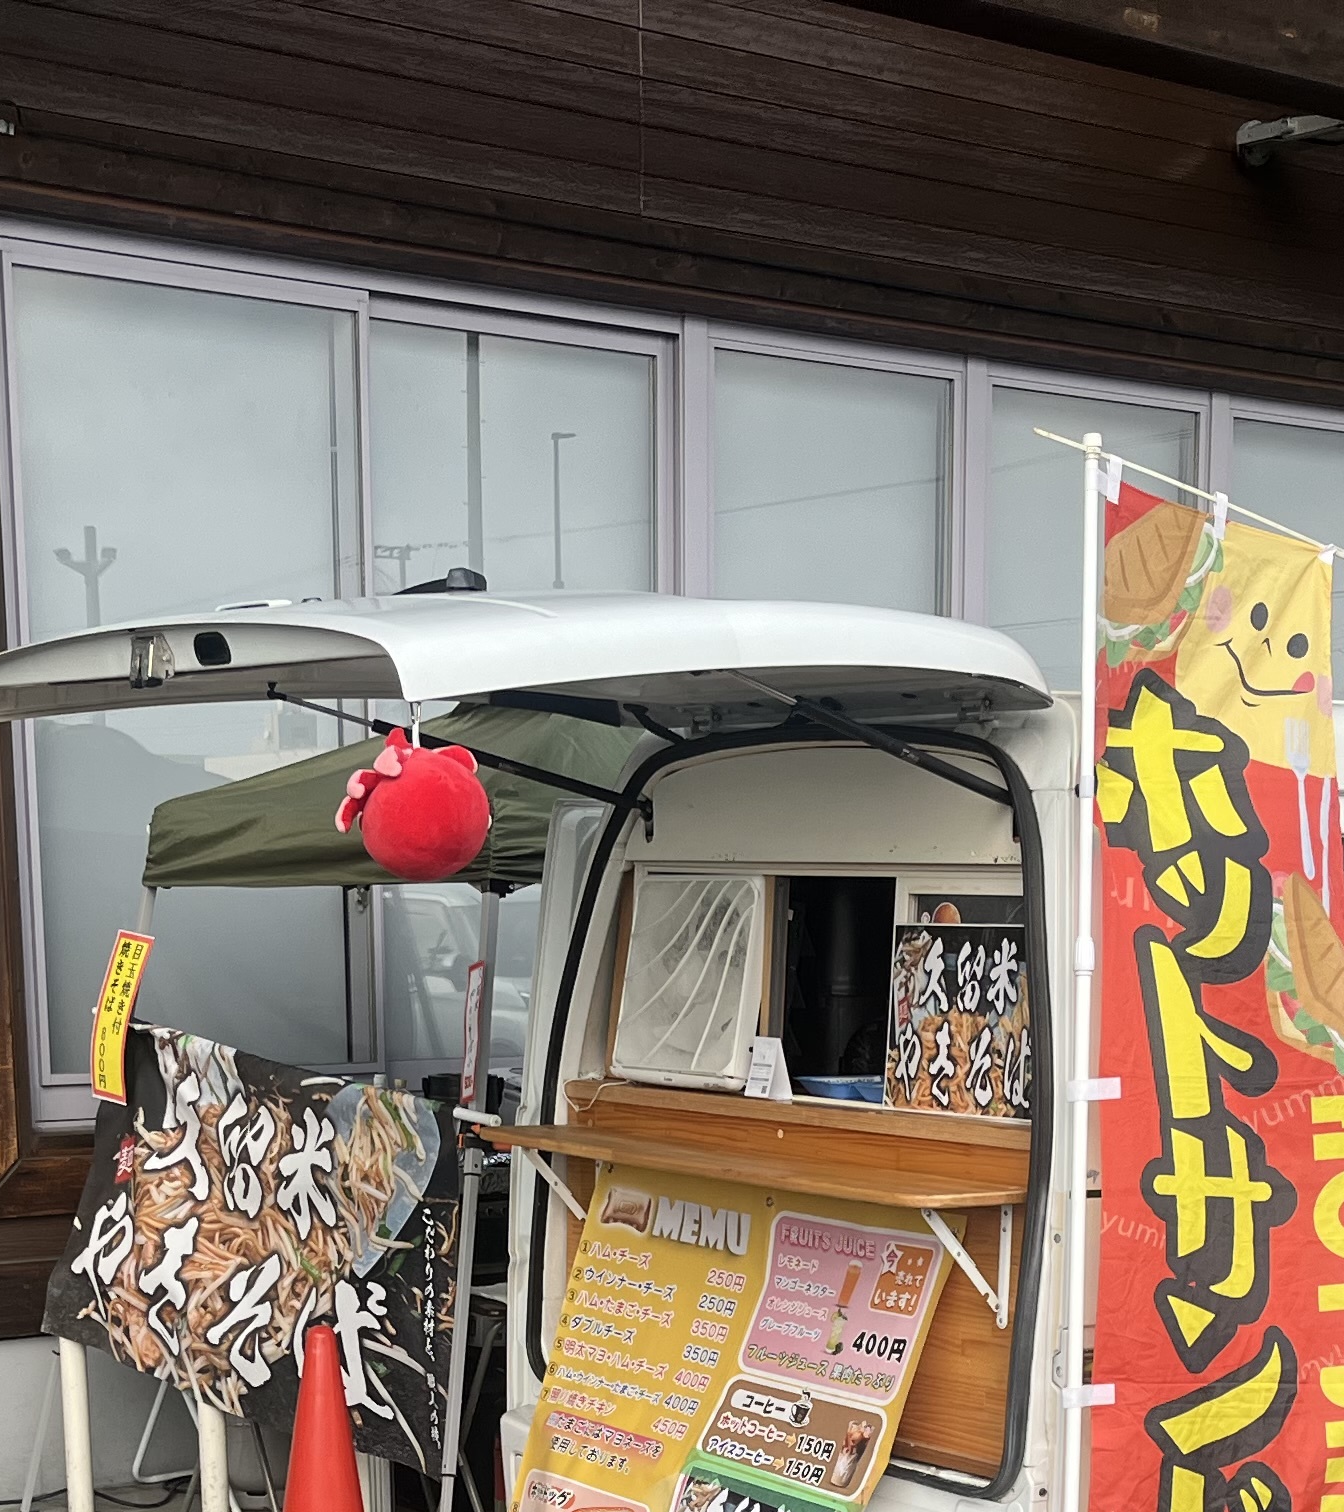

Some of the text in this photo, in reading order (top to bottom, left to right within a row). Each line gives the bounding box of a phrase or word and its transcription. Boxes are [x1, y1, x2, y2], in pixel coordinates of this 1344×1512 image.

[652, 1196, 751, 1257] MEMU
[781, 1224, 876, 1260] FRUITS JUICE
[706, 1269, 746, 1292] 250円
[698, 1294, 737, 1317] 250円
[691, 1319, 729, 1343] 350円
[682, 1344, 720, 1368] 350円
[852, 1331, 907, 1363] 400円
[673, 1370, 711, 1393] 400円
[662, 1394, 700, 1416] 400円
[742, 1394, 786, 1415] コーヒー
[650, 1416, 689, 1441] 450円
[719, 1412, 836, 1462] ホットコーヒー 150円
[708, 1437, 825, 1485] アイスコーヒー 150円
